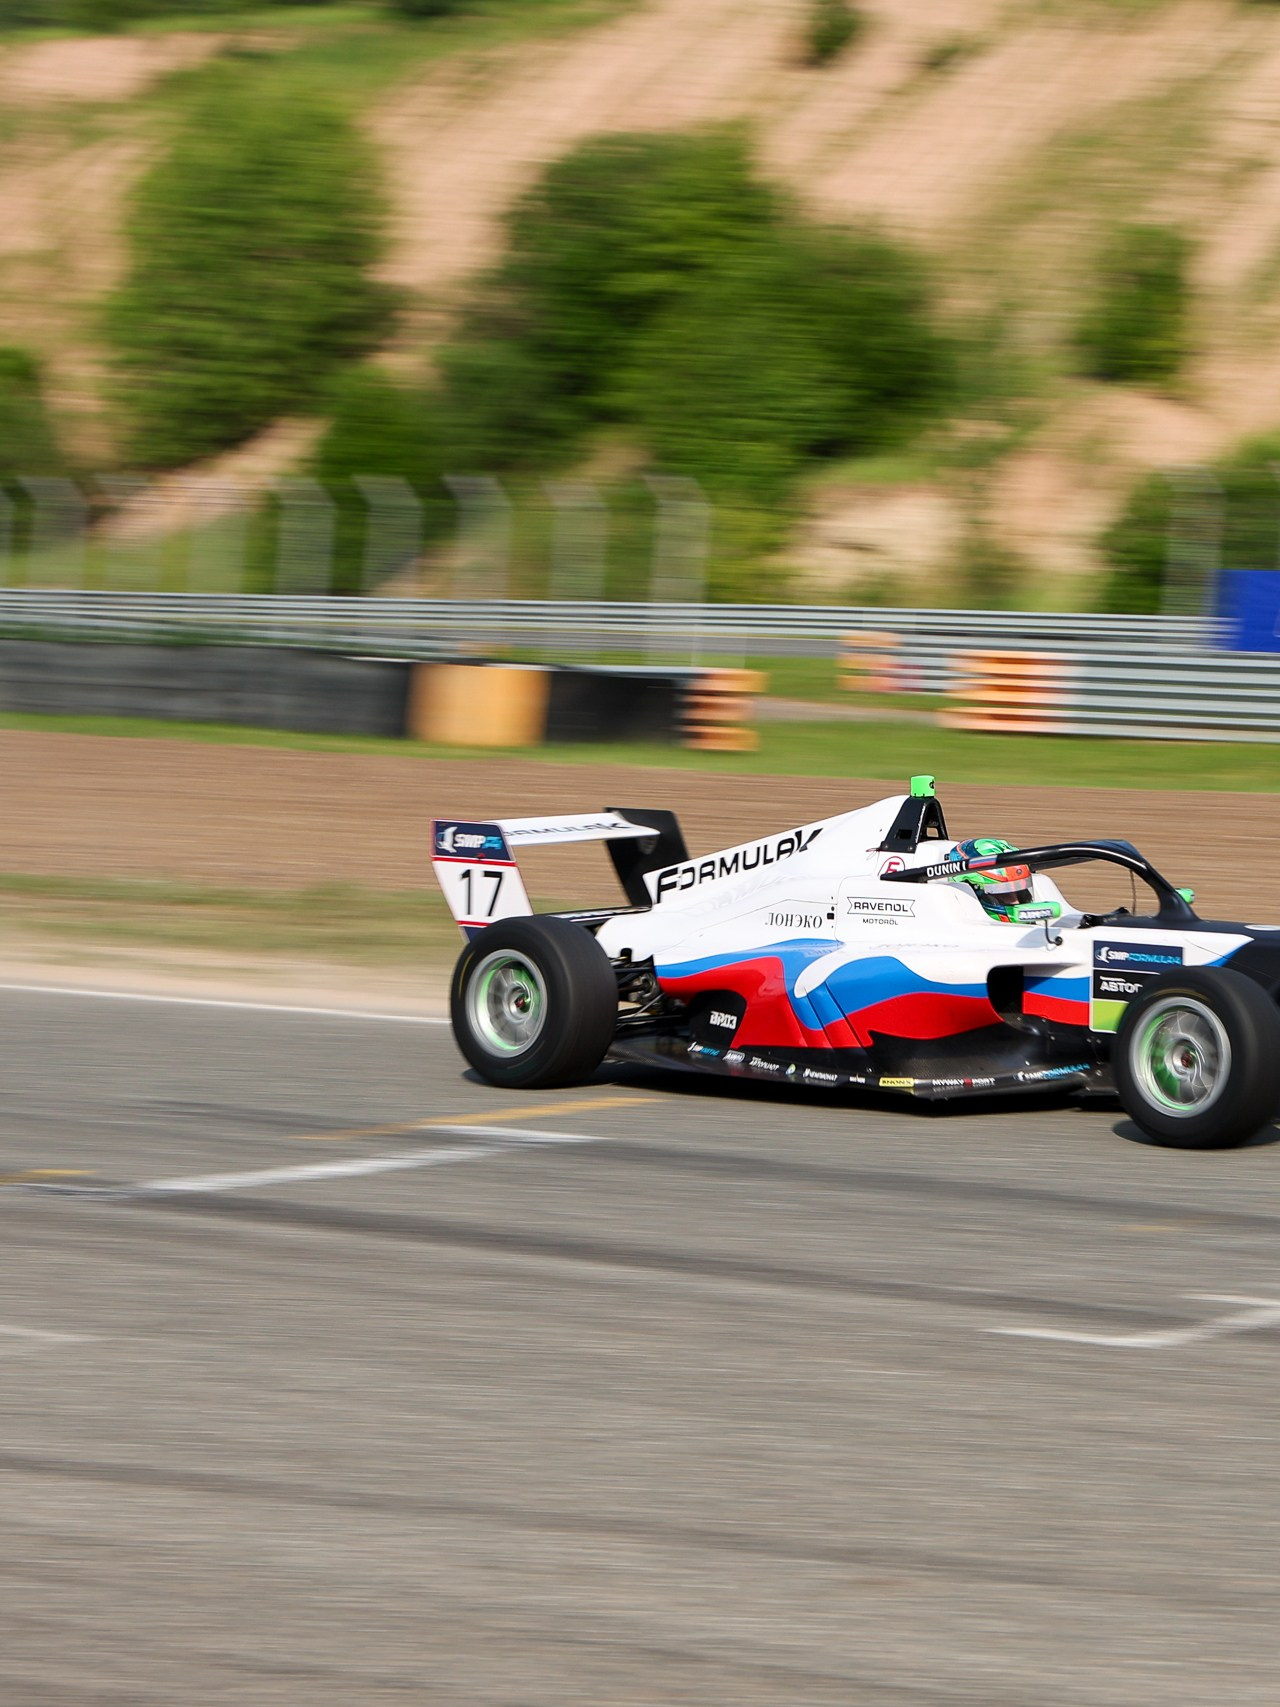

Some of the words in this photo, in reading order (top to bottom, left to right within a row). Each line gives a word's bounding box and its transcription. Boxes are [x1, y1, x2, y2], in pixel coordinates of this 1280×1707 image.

[926, 862, 960, 878] DUNIN
[460, 868, 503, 917] 17
[853, 901, 909, 912] RAVENOL
[765, 912, 823, 929] ЛОНЭКО
